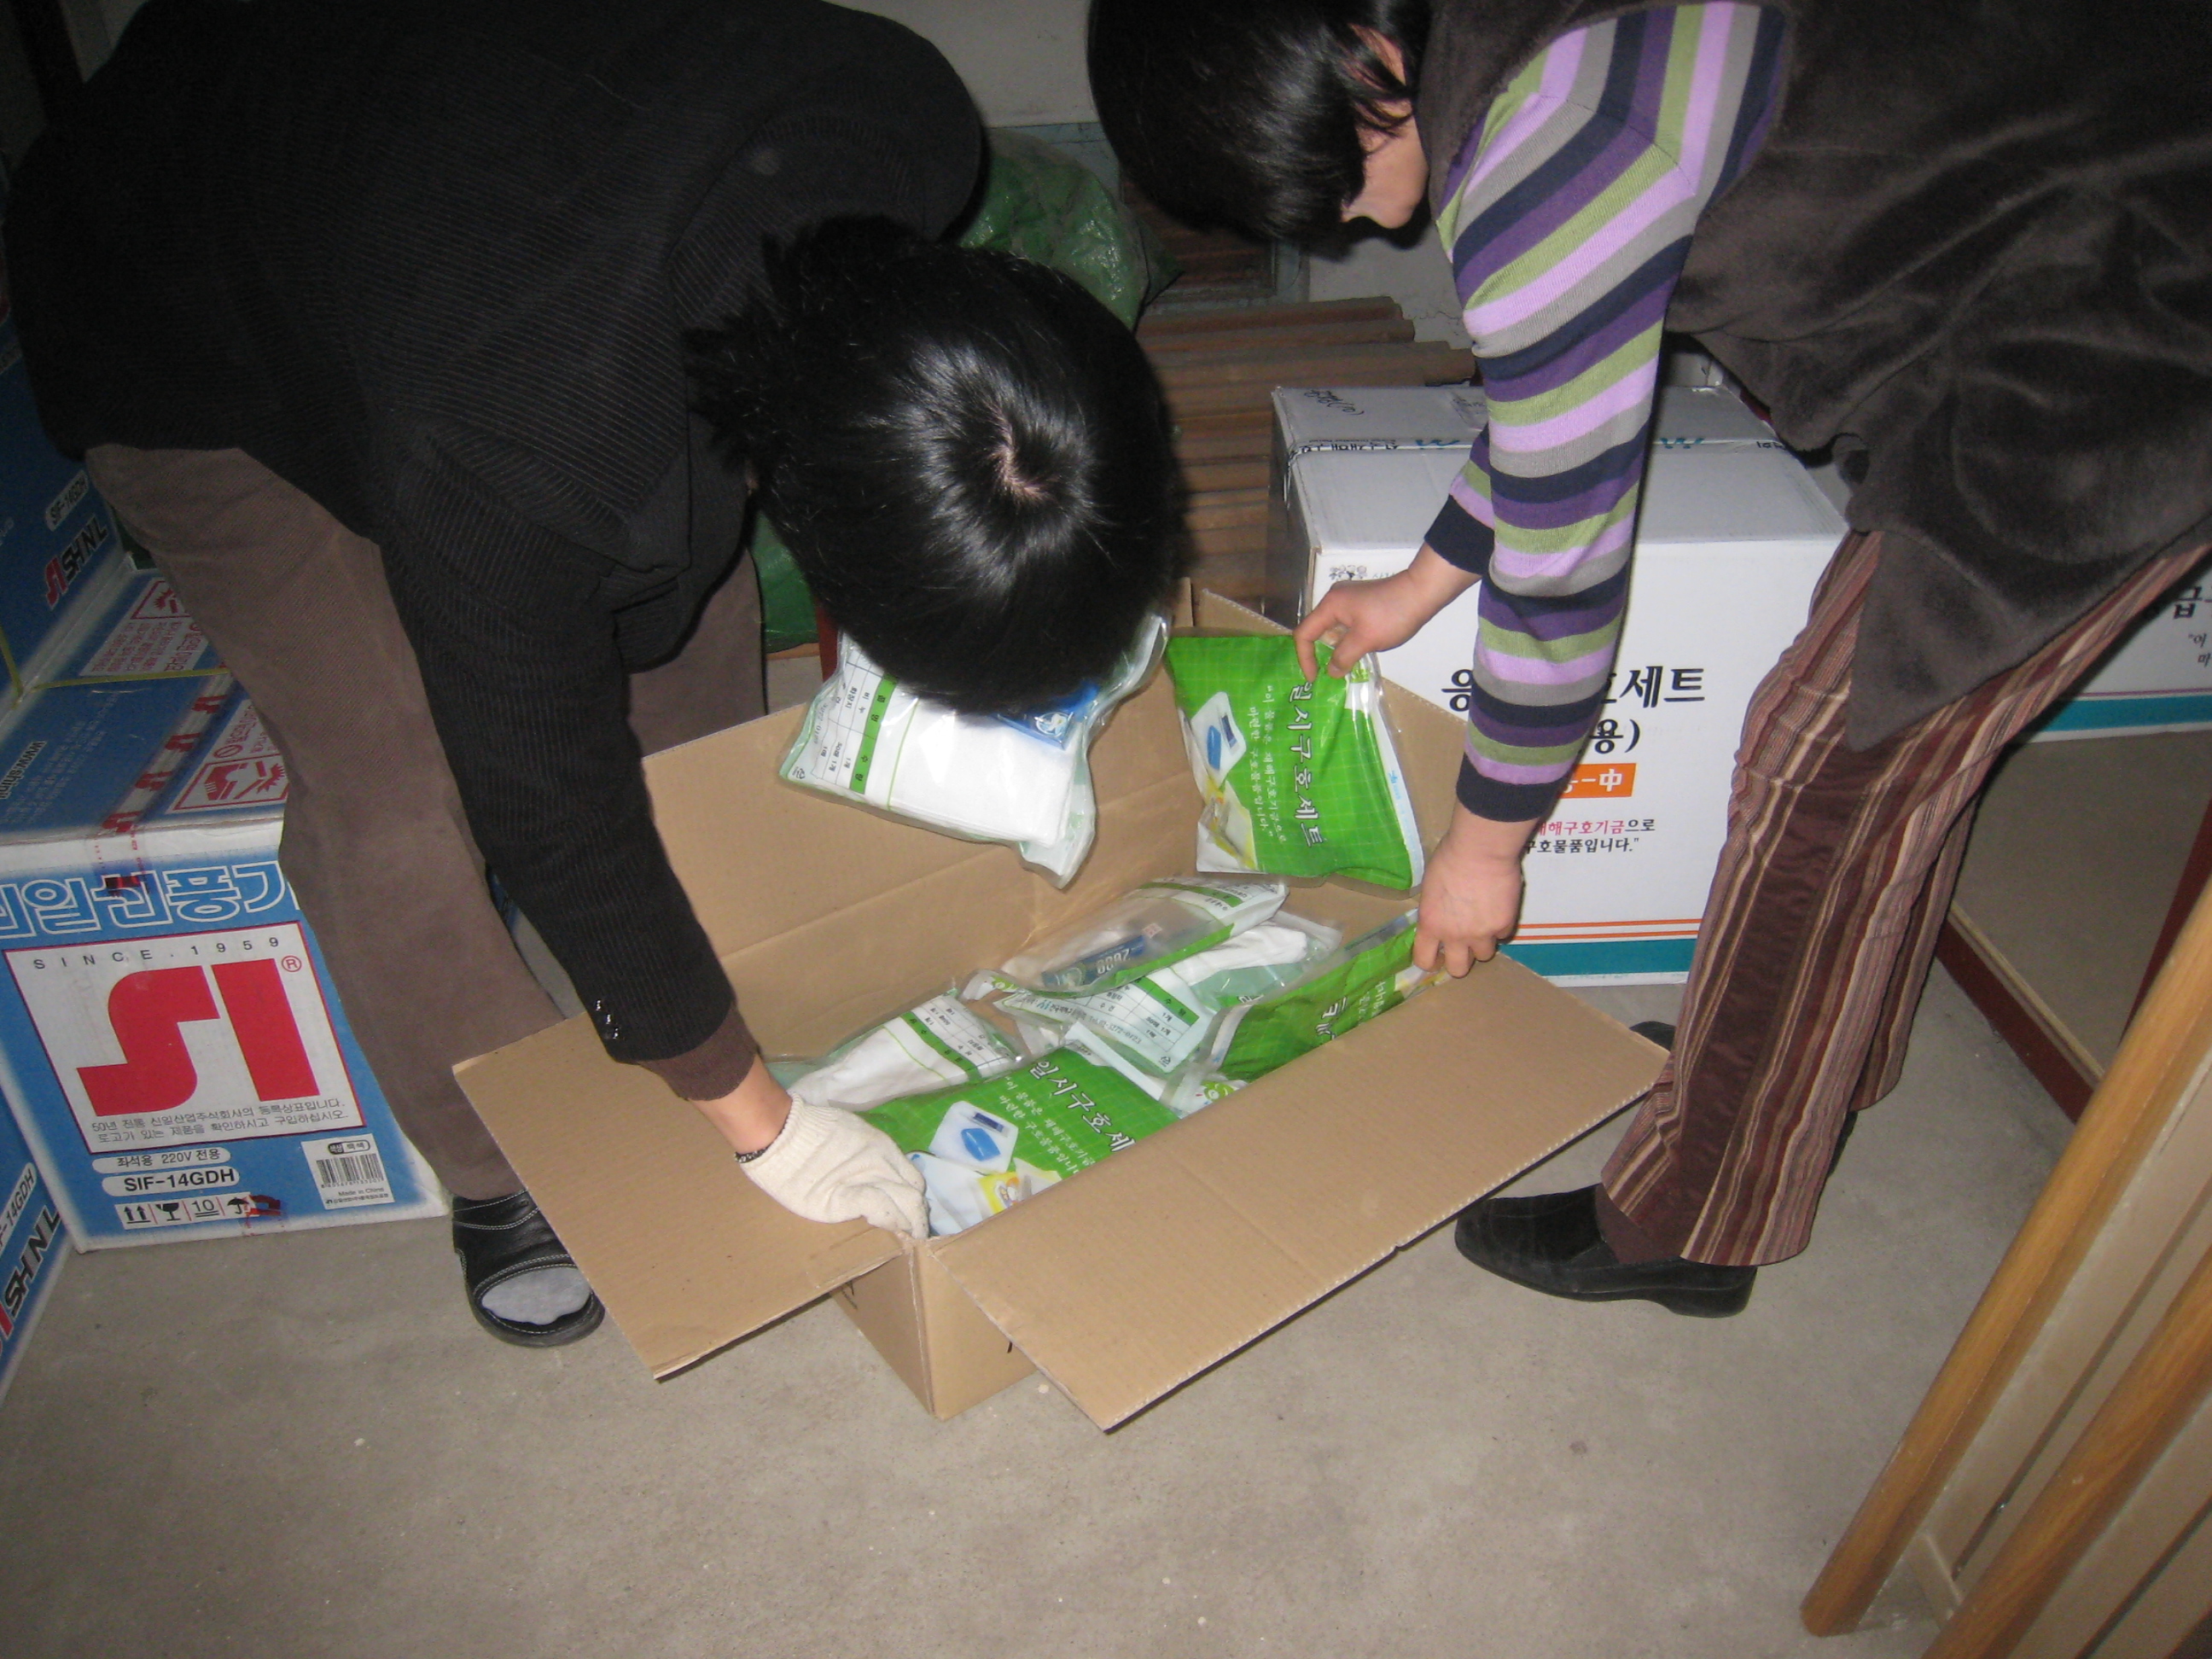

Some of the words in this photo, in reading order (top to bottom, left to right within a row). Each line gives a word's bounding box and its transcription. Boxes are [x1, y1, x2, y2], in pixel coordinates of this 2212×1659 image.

[1287, 681, 1327, 847] 일시구호세트
[92, 1121, 118, 1132] 50년
[98, 1131, 135, 1143] 로고가
[141, 1127, 165, 1139] 있는
[211, 1116, 270, 1132] 확인하시고
[161, 1150, 192, 1164] 220V
[195, 1148, 222, 1161] 전용
[124, 1168, 236, 1192] SIF-14GDH
